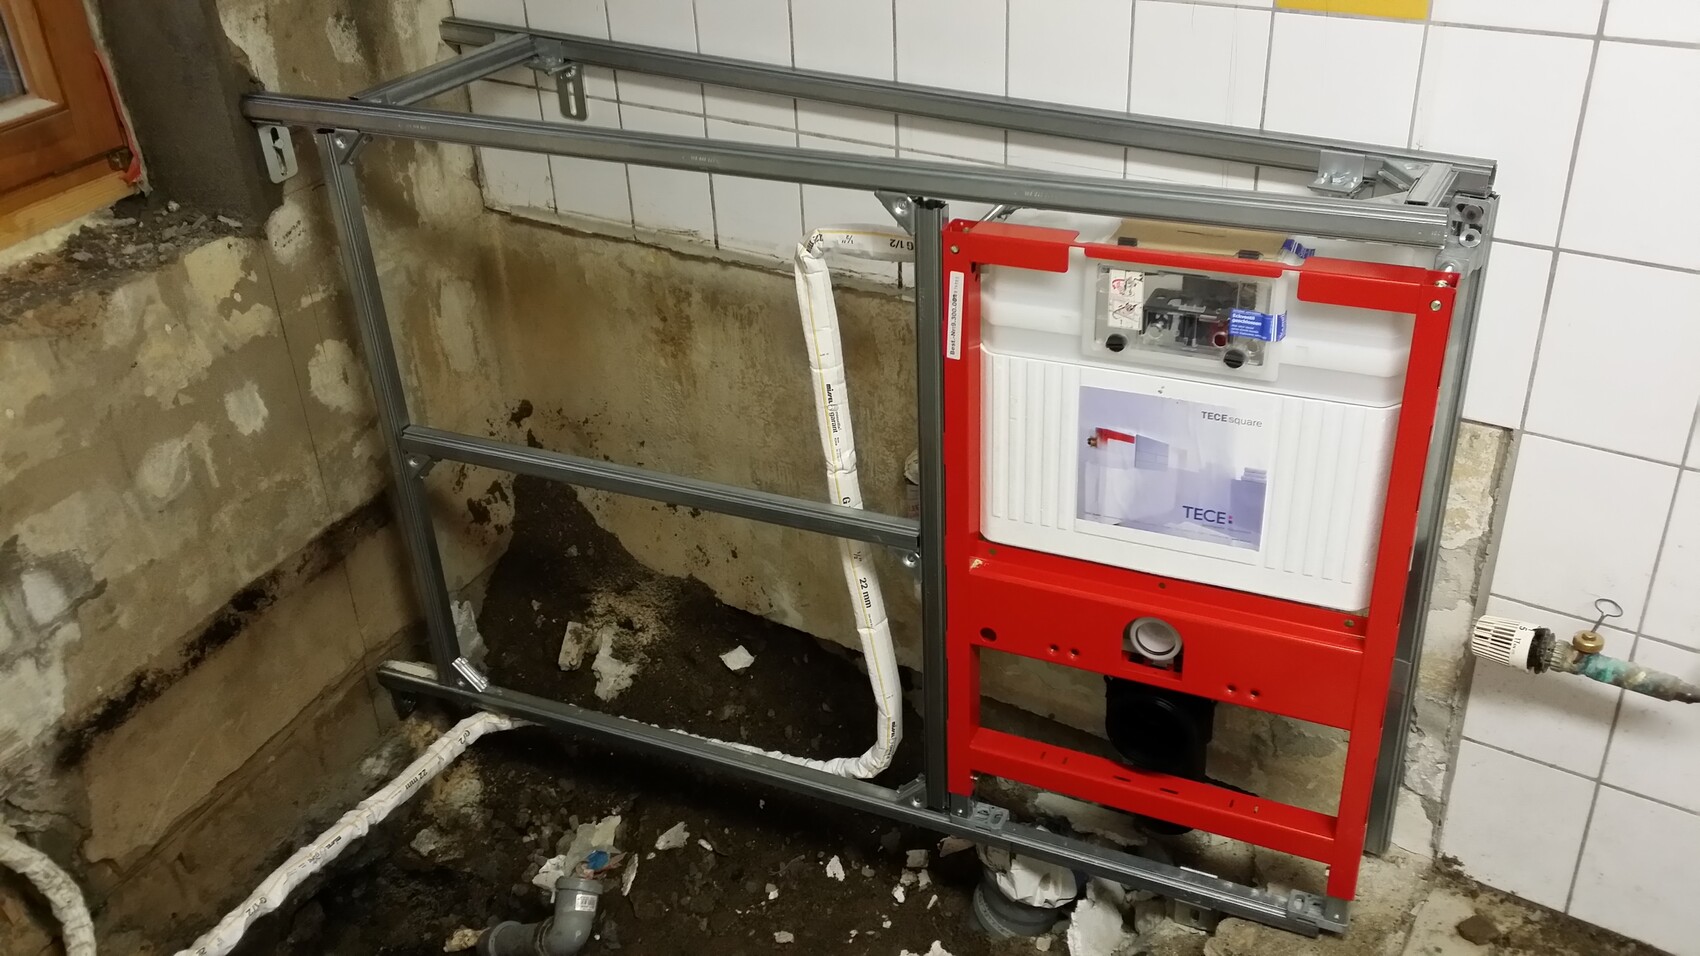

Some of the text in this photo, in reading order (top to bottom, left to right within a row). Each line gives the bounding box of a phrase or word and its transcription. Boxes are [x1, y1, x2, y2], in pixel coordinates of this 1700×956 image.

[889, 238, 914, 251] G 1/2
[859, 577, 869, 590] 22
[862, 591, 872, 608] mm
